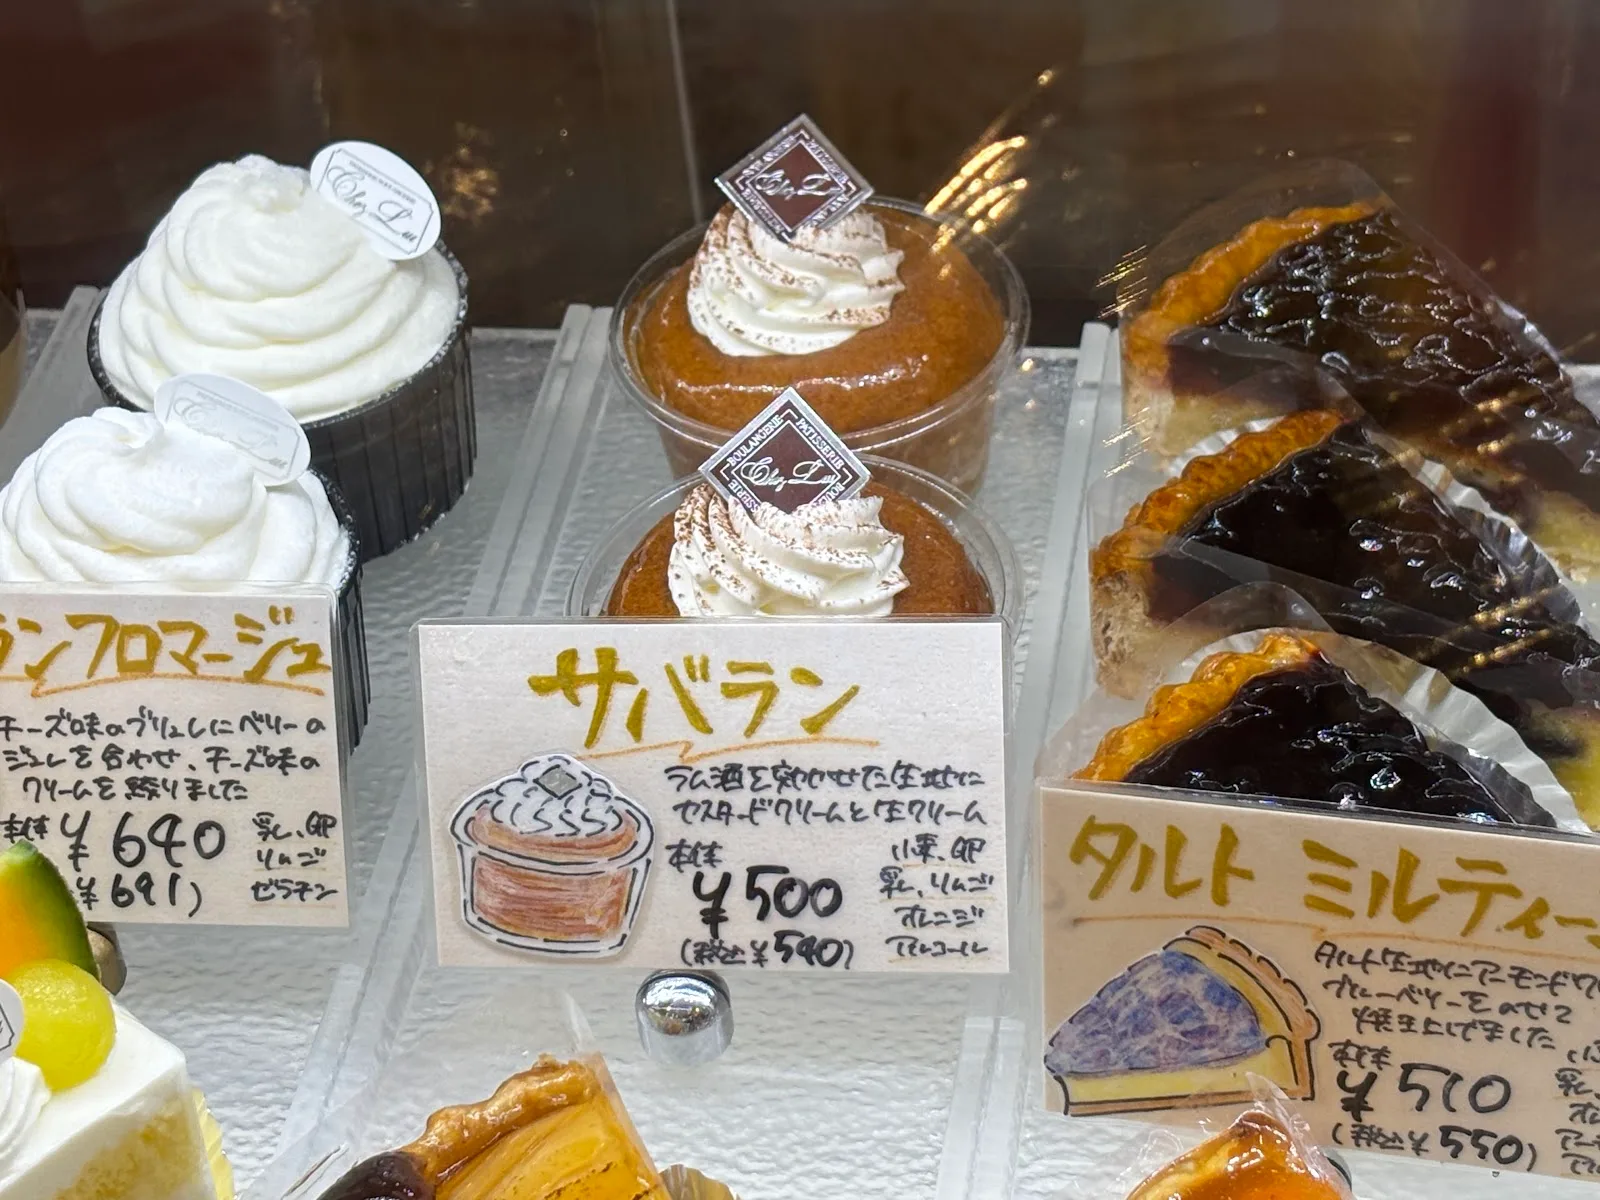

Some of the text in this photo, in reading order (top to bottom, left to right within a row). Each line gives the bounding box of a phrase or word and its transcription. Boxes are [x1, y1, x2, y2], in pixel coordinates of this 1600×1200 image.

[526, 646, 861, 750] サバラン
[691, 864, 844, 940] ¥500
[1069, 815, 1600, 951] タルト ミルティー
